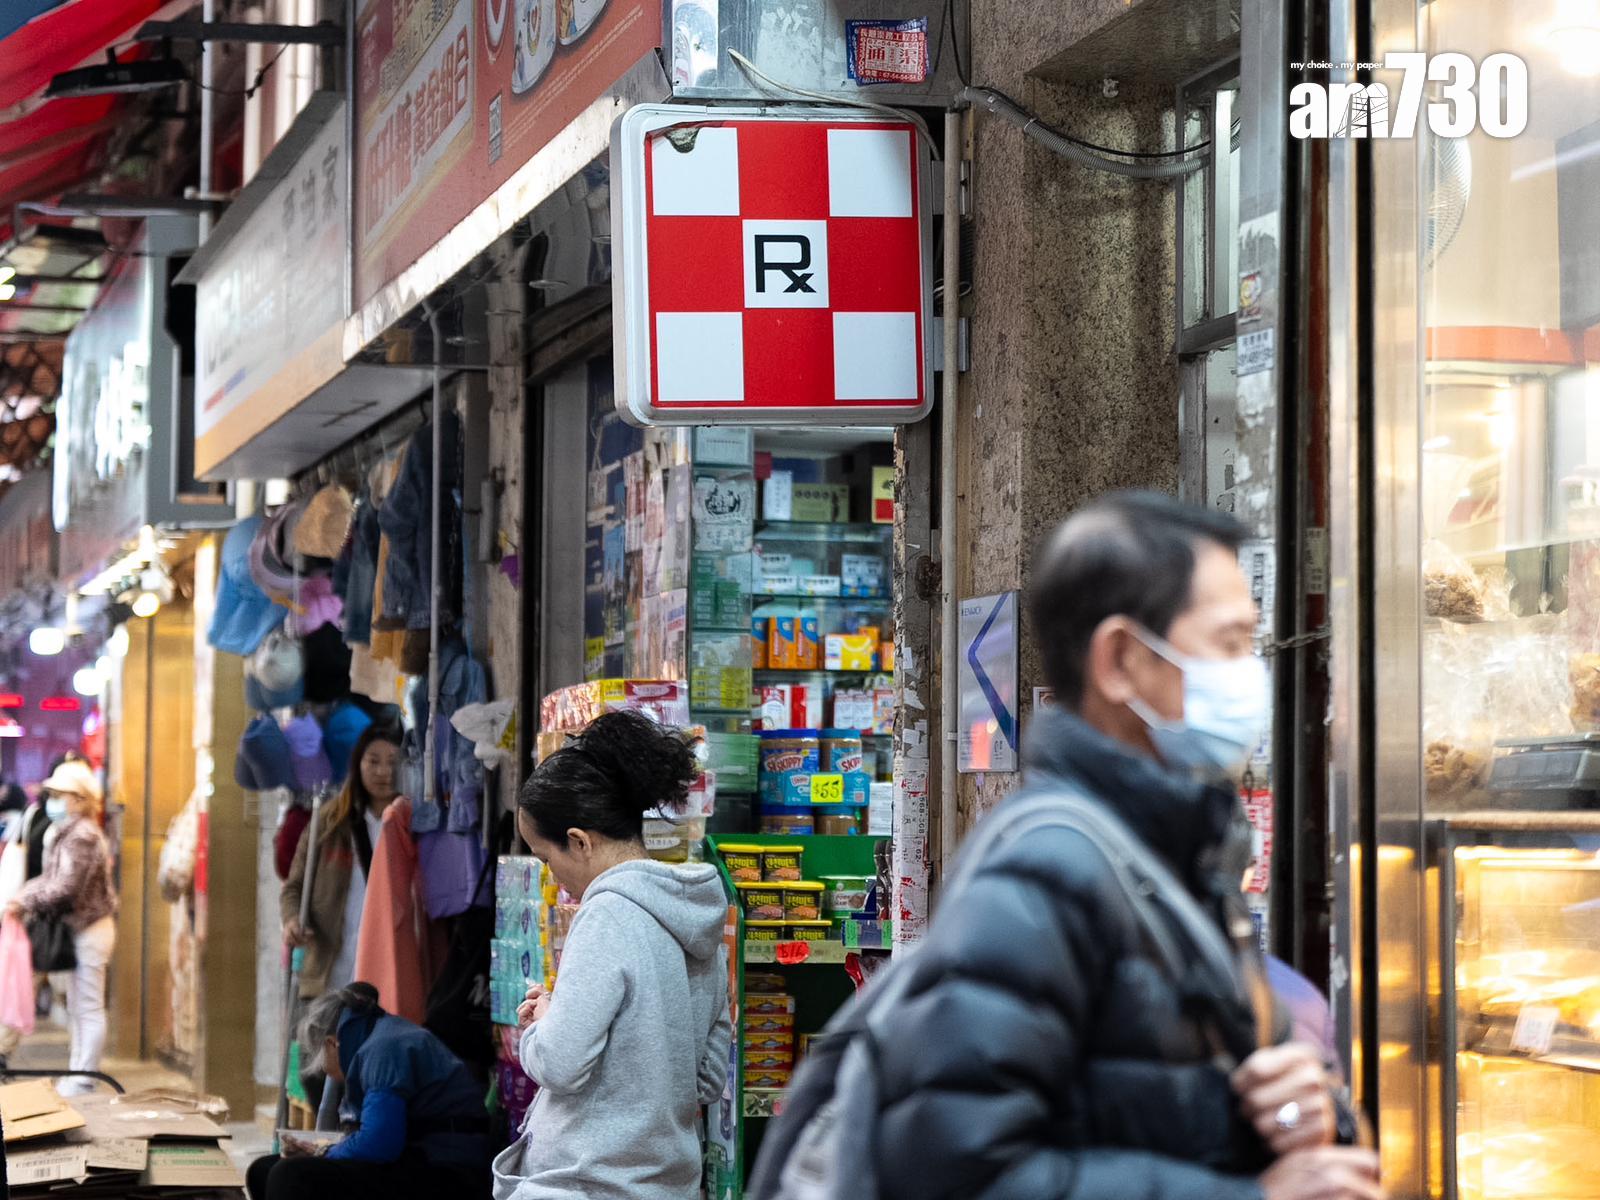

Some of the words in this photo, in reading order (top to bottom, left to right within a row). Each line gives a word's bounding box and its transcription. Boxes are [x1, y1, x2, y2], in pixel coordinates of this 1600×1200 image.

[755, 234, 817, 293] Rx
[776, 757, 802, 770] SKIPPY
[814, 780, 840, 799] $55
